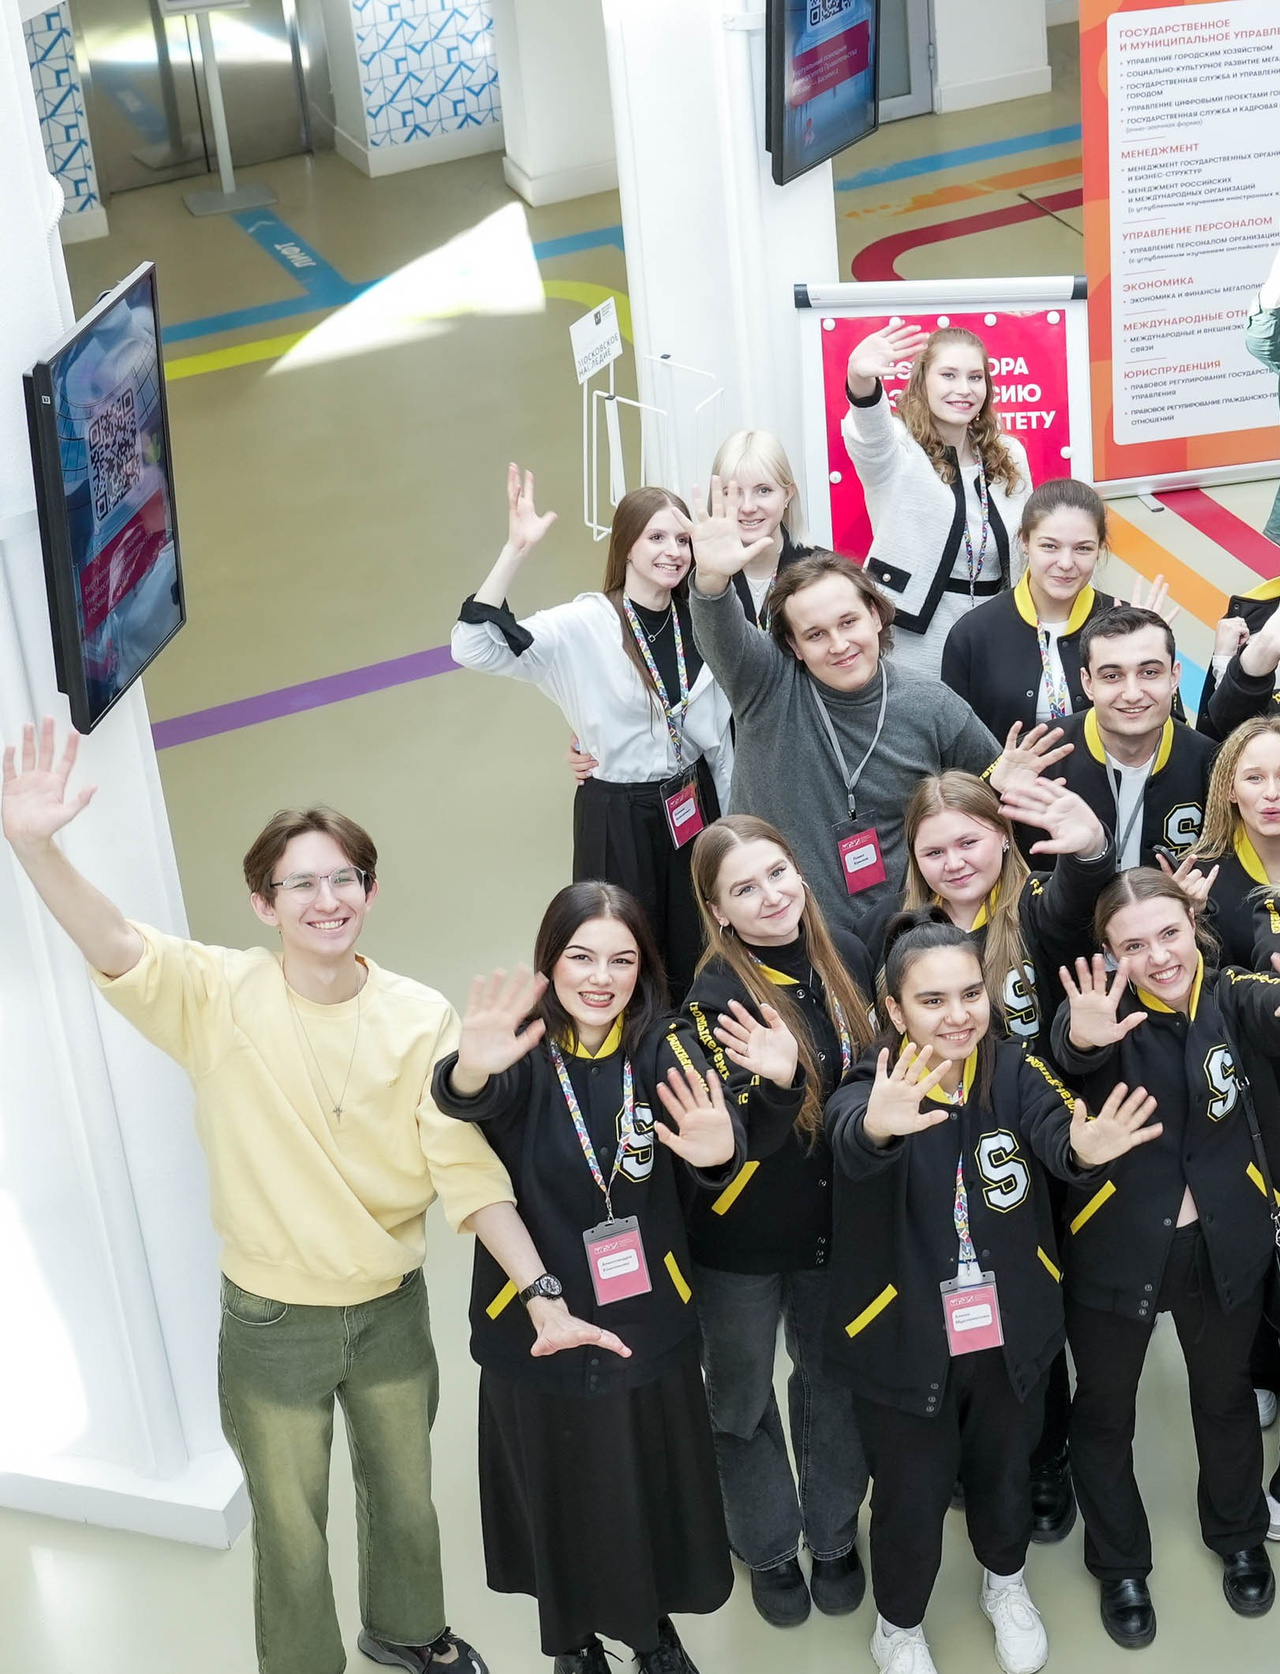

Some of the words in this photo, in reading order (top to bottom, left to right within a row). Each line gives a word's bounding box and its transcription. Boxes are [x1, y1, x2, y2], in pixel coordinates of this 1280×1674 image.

[1119, 19, 1230, 38] ГОСУДАРСТВЕННОЕ
[1130, 32, 1230, 51] МУНИЦИПАЛЬНОЕ
[1126, 55, 1172, 66] УПРАВЛЕНИЕ
[1174, 50, 1221, 60] ГОРОДСКИМ
[1223, 45, 1273, 55] ХОЗЯЙСТВОМ
[1126, 63, 1222, 77] СОЦИАЛЬНО-КУЛЬТУРНОЕ
[1224, 58, 1259, 67] РАЗВИТИЕ
[1126, 77, 1197, 90] ГОСУДАРСТВЕННАЯ
[1200, 74, 1231, 82] СЛУЖБА
[1127, 90, 1163, 99] ГОРОДОМ
[1127, 101, 1172, 112] УПРАВЛЕНИЕ
[1174, 96, 1222, 107] ЦИФРОВЫМИ
[1224, 92, 1268, 101] ПРОЕКТАМИ
[1127, 111, 1198, 124] ГОСУДАРСТВЕННАЯ
[1200, 108, 1231, 116] СЛУЖБА
[1240, 103, 1278, 112] КАДРОВАЯ
[1121, 143, 1199, 159] МЕНЕДЖМЕНТ
[1128, 161, 1178, 173] МЕНЕДЖМЕНТ
[1180, 153, 1252, 166] ГОСУДАРСТВЕННЫХ
[1134, 168, 1202, 180] БИЗНЕС-СТРУКТУР
[1128, 183, 1178, 194] МЕНЕДЖМЕНТ
[1180, 177, 1232, 188] РОССИЙСКИХ
[1134, 189, 1202, 202] МЕЖДУНАРОДНЫХ
[1204, 183, 1255, 195] ОРГАНИЗАЦИЙ
[1122, 225, 1192, 240] УПРАВЛЕНИЕ
[1195, 216, 1273, 232] ПЕРСОНАЛОМ
[1130, 242, 1174, 254] УПРАВЛЕНИЕ
[1176, 237, 1227, 248] ПЕРСОНАЛОМ
[1123, 277, 1194, 292] ЭКОНОМИКА
[1130, 293, 1176, 304] ЭКОНОМИКА
[1185, 287, 1221, 298] ФИНАНСЫ
[1124, 311, 1224, 331] МЕЖДУНАРОДНЫЕ
[1130, 330, 1195, 342] МЕЖДУНАРОДНЫЕ
[1130, 345, 1154, 353] СВЯЗИ
[988, 356, 1029, 377] ОРА
[1124, 360, 1221, 379] ЮРИСПРУДЕНЦИЯ
[1131, 380, 1167, 390] ПРАВОВОЕ
[1169, 373, 1226, 386] РЕГУЛИРОВАНИЕ
[1131, 390, 1177, 401] УПРАВЛЕНИЯ
[1131, 405, 1166, 415] ПРАВОВОЕ
[1167, 399, 1221, 410] РЕГУЛИРОВАНИЕ
[1131, 414, 1174, 426] ОТНОШЕНИЙ
[974, 1128, 1031, 1213] S
